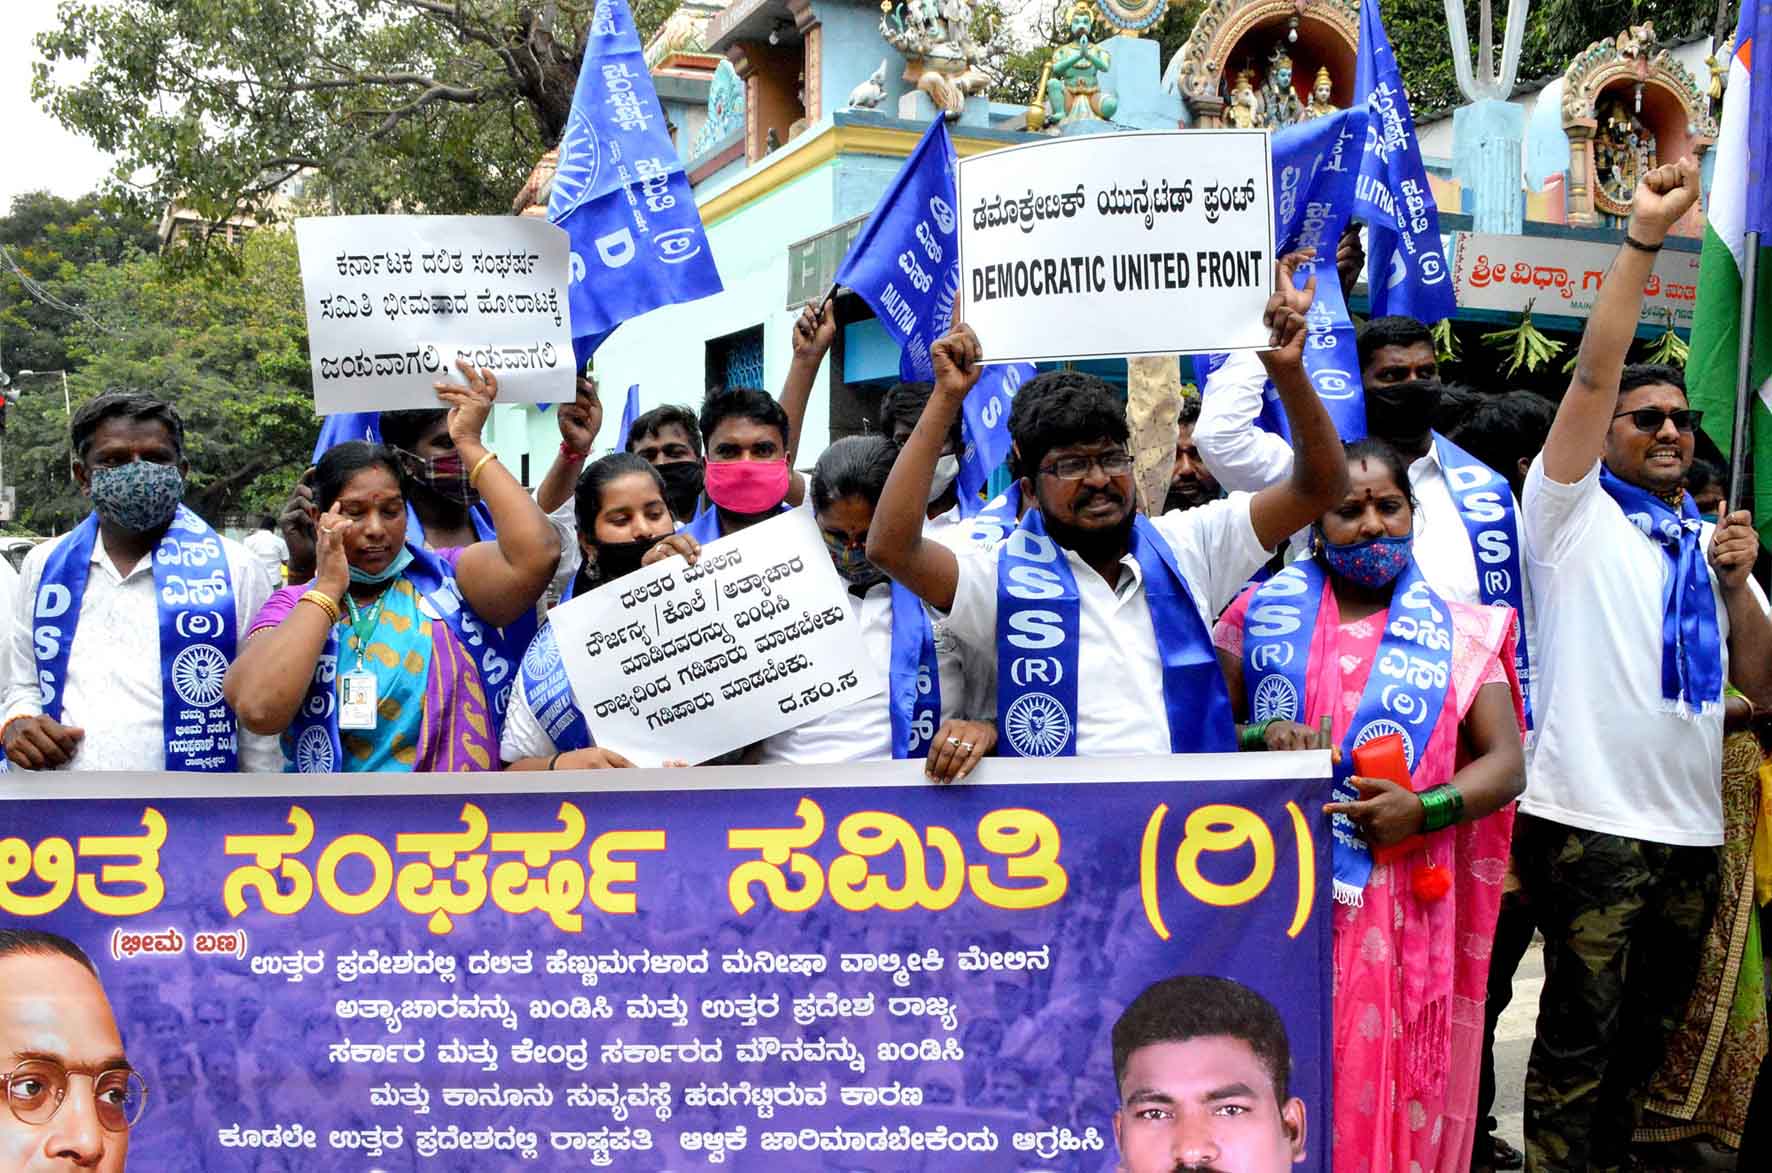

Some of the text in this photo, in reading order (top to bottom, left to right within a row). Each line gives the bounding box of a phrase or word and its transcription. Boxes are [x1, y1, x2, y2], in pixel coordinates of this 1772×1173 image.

[336, 249, 539, 279] ಕರ್ನಾಟಕ ದಲಿತ ಸಂಘರ್ಷ
[972, 250, 1262, 302] DEMOCRATIC UNITED FRONT
[319, 292, 373, 319] ಸಮಿತಿ
[881, 282, 917, 336] DALITHA
[620, 573, 675, 609] ದಲಿತರ
[1485, 569, 1512, 595] (R)
[175, 610, 225, 638] (ರಿ)
[734, 594, 790, 629] ಬಂಧಿಸಿ
[677, 644, 748, 686] ಗಡಿಪಾರು
[754, 606, 845, 653] ಮಾಡಬೇಕು
[1250, 640, 1295, 672] (R)
[1010, 656, 1064, 687] (R)
[646, 692, 715, 731] ಗಡಿಪಾರು
[222, 801, 667, 935] ಸಂಘರ್ಷ
[727, 797, 1069, 916] ಸಮಿತಿ
[1139, 800, 1317, 941] (ರಿ)
[251, 945, 1049, 986] ಉತ್ತರ ಪ್ರದೇಶದಲ್ಲಿ ದಲಿತ ಹೆಣ್ಣುಮಗಳಾದ ಮನೀಷಾ ವಾಲ್ಮೀಕಿ ಮೇಲಿನ
[336, 992, 958, 1034] ಅತ್ಯಾಚಾರವನ್ನು ಖಂಡಿಸಿ ಮತ್ತು ಉತ್ತರ ಪ್ರದೇಶ ರಾಜ್ಯ
[329, 1037, 964, 1073] ಸರ್ಕಾರ ಮತ್ತು ಕೇಂದ್ರ ಸರ್ಕಾರದ ಮೌನವನ್ನು ಖಂಡಿಸಿ
[370, 1081, 923, 1121] ಮತ್ತು ಕಾನೂನು ಸುವ್ಯವಸ್ಥೆ ಹದಗೆಟ್ಟಿರುವ ಕಾರಣ
[219, 1123, 316, 1148] ಕೂಡಲೇ
[329, 1125, 403, 1156] ಉತ್ತರ
[416, 1125, 537, 1158] ಪ್ರದೇಶದಲ್ಲಿ
[761, 1126, 998, 1151] ಜಾರಿಮಾಡಬೇಕೆಂದು
[1013, 1126, 1104, 1158] ಆಗ್ರಹಿಸಿ
